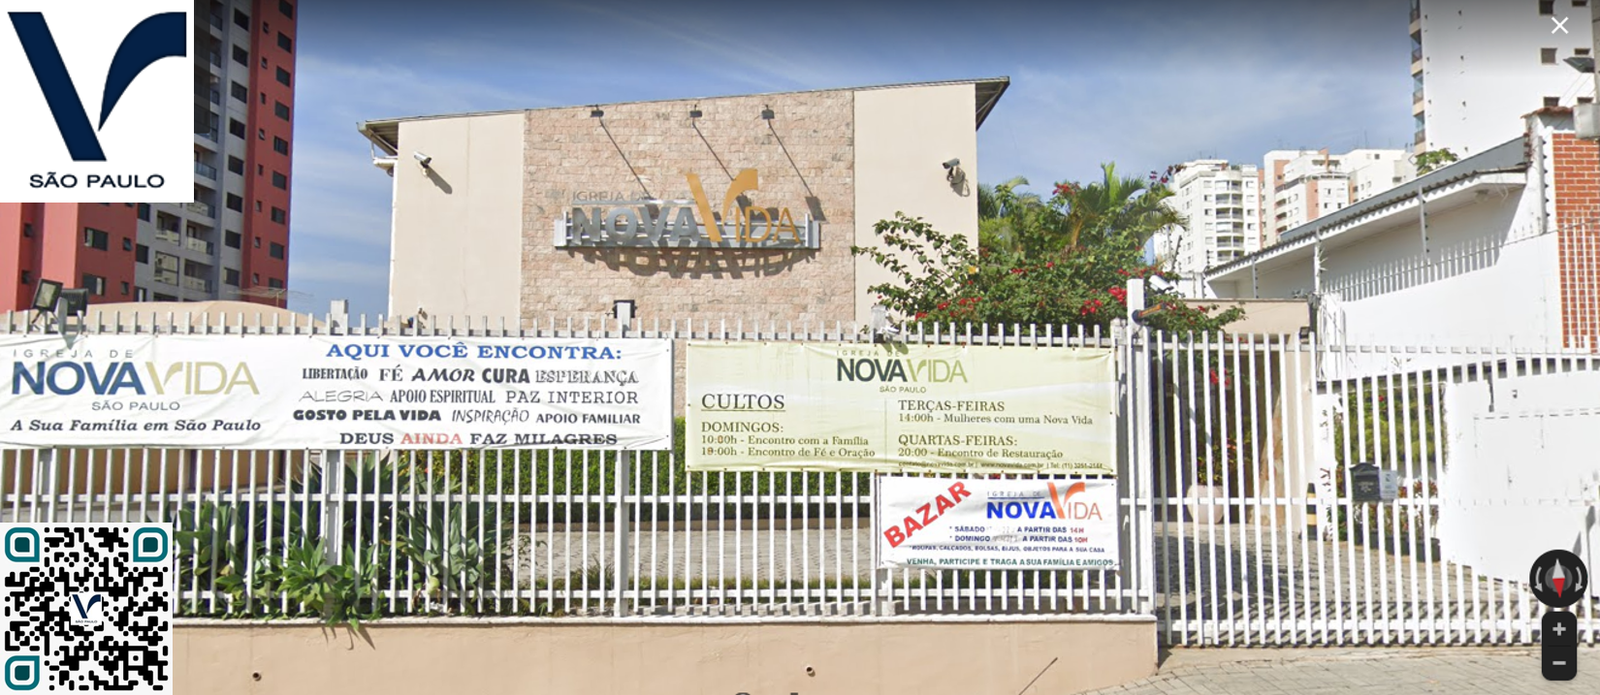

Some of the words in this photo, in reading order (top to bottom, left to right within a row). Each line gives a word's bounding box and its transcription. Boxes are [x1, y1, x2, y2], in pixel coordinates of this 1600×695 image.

[572, 190, 624, 201] IGREJA
[13, 349, 93, 358] IGREJA
[110, 349, 134, 358] DE
[326, 344, 390, 360] AQUI
[398, 341, 469, 359] VOCÊ
[477, 345, 623, 361] ENCONTRA:
[302, 366, 368, 381] LIBERTAÇÃO
[379, 367, 404, 382] FÉ
[411, 368, 476, 382] AMOR
[481, 368, 531, 383] CURA
[535, 370, 640, 384] ESPERANÇA
[899, 386, 926, 394] PAULO
[298, 389, 384, 403] ALEGRIA
[390, 390, 427, 403] APOIO
[430, 390, 497, 404] ESPIRITUAL
[505, 391, 541, 404] PAZ
[547, 392, 639, 405] INTERIOR
[701, 393, 785, 410] CULTOS
[91, 401, 124, 411] SÃO
[129, 401, 181, 411] PAULO
[898, 399, 1005, 413] TERÇAS-FEIRAS
[293, 409, 348, 421] GOSTO
[352, 409, 397, 421] PELA
[399, 409, 442, 422] VIDA
[452, 407, 530, 425] INSPIRAÇÃO
[536, 413, 578, 424] APOIO
[582, 413, 641, 425] FAMILIAR
[898, 413, 934, 423] 14:00h
[943, 413, 991, 424] Mulheres
[994, 416, 1015, 424] com
[1018, 417, 1040, 425] uma
[1043, 415, 1069, 424] Nova
[1071, 415, 1094, 425] Vida
[10, 419, 24, 431] A
[29, 419, 64, 431] Sua
[69, 418, 138, 431] Família
[143, 421, 169, 431] em
[174, 419, 208, 431] São
[211, 419, 261, 431] Paulo
[701, 421, 784, 433] DOMINGOS:
[339, 433, 395, 445] DEUS
[400, 433, 463, 445] AINDA
[470, 433, 508, 445] FAZ
[514, 433, 618, 445] MILAGRES
[748, 435, 795, 445] Encontro
[798, 438, 821, 446] com
[823, 438, 829, 446] a
[832, 436, 869, 446] Família
[898, 434, 1018, 447] QUARTAS-FEIRAS:
[748, 446, 795, 457] Encontro
[798, 447, 810, 457] de
[814, 447, 827, 457] Fé
[838, 447, 876, 459] Oração
[898, 448, 928, 457] 20:00
[937, 448, 984, 458] Encontro
[986, 448, 999, 458] de
[1002, 449, 1063, 460] Restauração
[883, 480, 972, 548] BAZAR
[906, 558, 937, 566] VENHA,
[1043, 558, 1075, 566] FAMÍLIA
